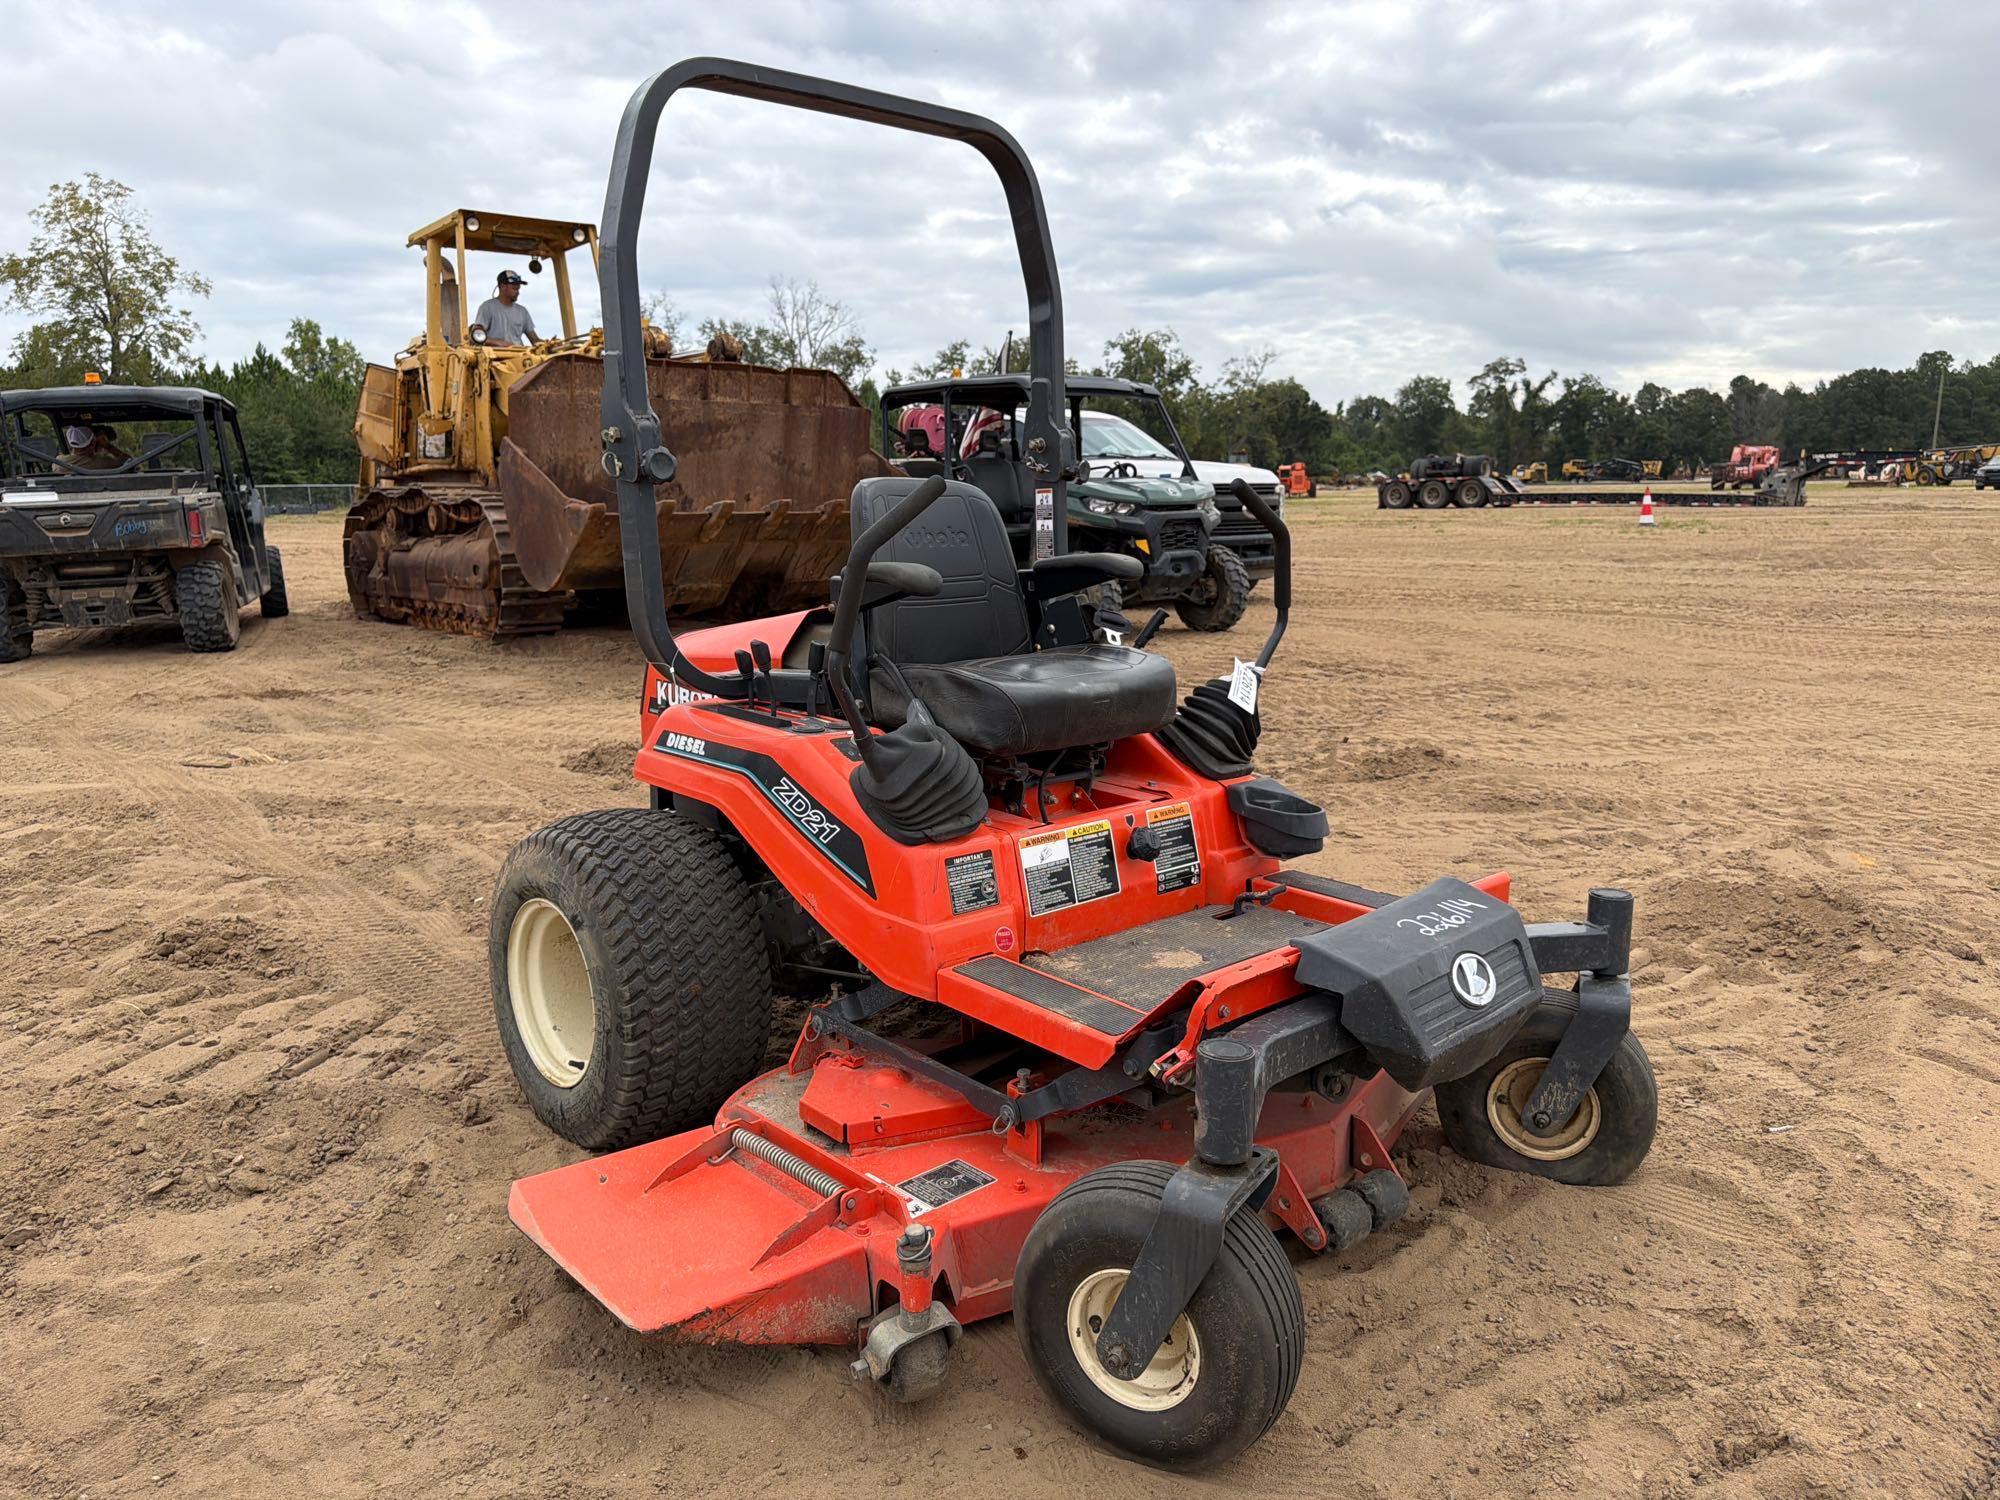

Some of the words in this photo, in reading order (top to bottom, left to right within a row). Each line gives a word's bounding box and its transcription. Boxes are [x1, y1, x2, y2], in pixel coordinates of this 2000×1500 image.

[666, 732, 706, 756] DIESEL
[771, 776, 841, 844] ZD21
[1159, 806, 1185, 818] WARNING
[1077, 822, 1104, 835] CAUTION
[1031, 832, 1060, 846] WARNING
[953, 853, 984, 864] IMPORTANT
